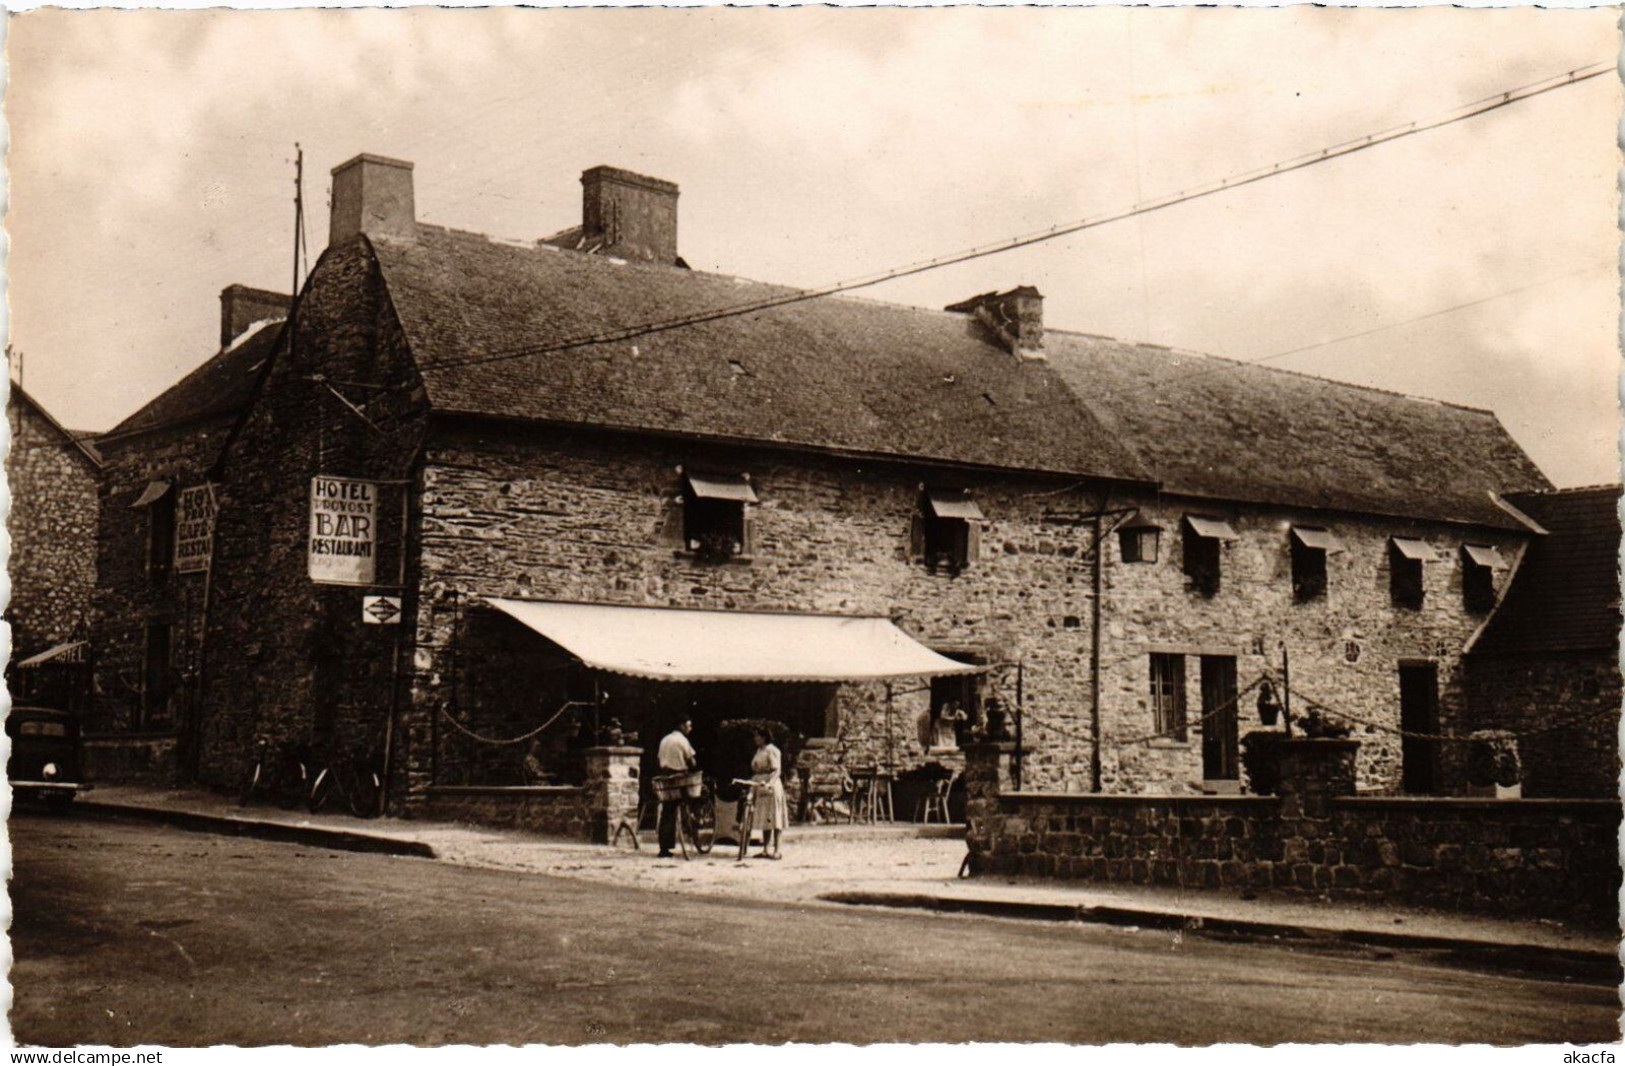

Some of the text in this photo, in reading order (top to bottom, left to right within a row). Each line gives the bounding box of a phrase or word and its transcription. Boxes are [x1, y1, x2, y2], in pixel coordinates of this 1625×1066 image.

[316, 481, 371, 501] HOTEL
[314, 500, 373, 513] PROVOST
[315, 513, 371, 539] BAR
[312, 539, 373, 557] RESTAURANT
